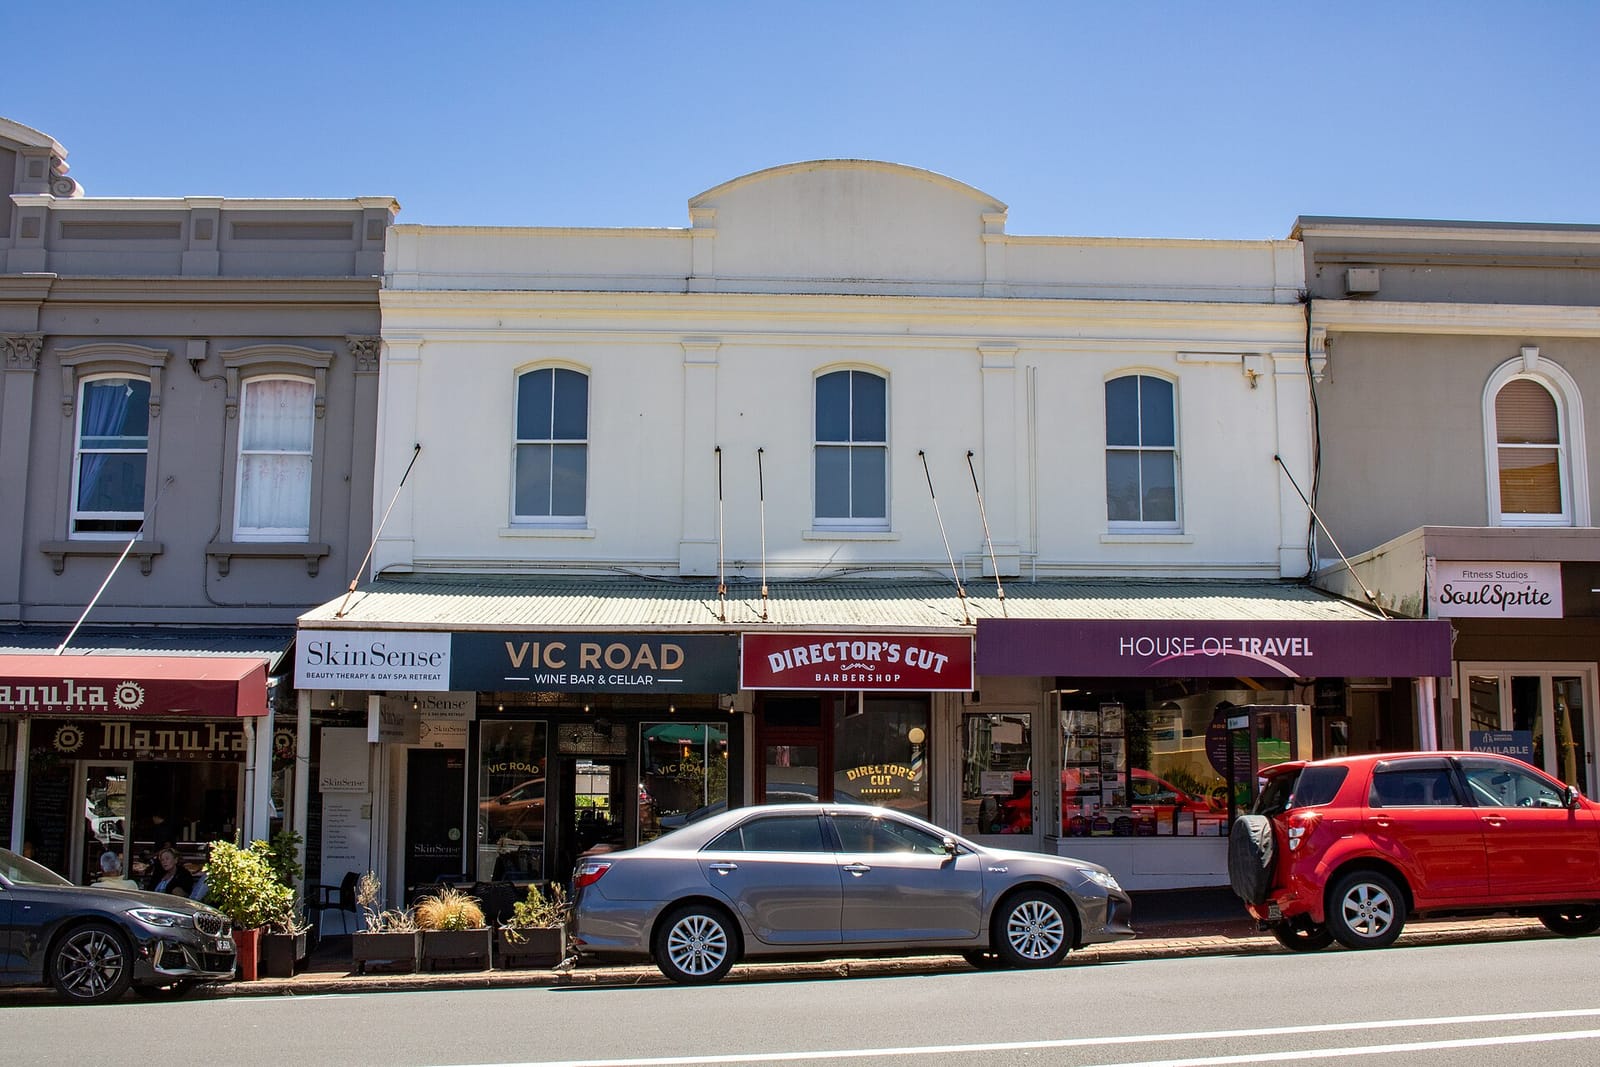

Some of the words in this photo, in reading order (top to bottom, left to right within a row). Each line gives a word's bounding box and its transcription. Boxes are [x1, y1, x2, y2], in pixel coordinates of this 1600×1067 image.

[1462, 571, 1493, 579] Fitness
[1495, 571, 1528, 579] Studios
[1440, 584, 1552, 611] SoulSprite
[307, 641, 442, 667] SkinSense
[1120, 637, 1195, 657] HOUSE
[1201, 637, 1233, 657] OF
[1239, 637, 1313, 657] TRAVEL
[504, 641, 567, 669] VIC
[579, 642, 685, 670] ROAD
[767, 641, 900, 673] DIRECTOR'S
[904, 646, 949, 673] CUT
[534, 674, 567, 684] WINE
[570, 674, 595, 685] BAR
[597, 675, 606, 685] &
[608, 675, 653, 685] CELLAR
[815, 673, 901, 682] BARBERSHOP
[100, 722, 247, 750] Manuka
[1473, 746, 1529, 754] AVAILABLE
[488, 763, 507, 774] VIC
[509, 762, 540, 774] ROAD
[658, 764, 677, 775] VIC
[846, 764, 916, 781] DIRECTOR'S
[870, 775, 892, 785] CUT
